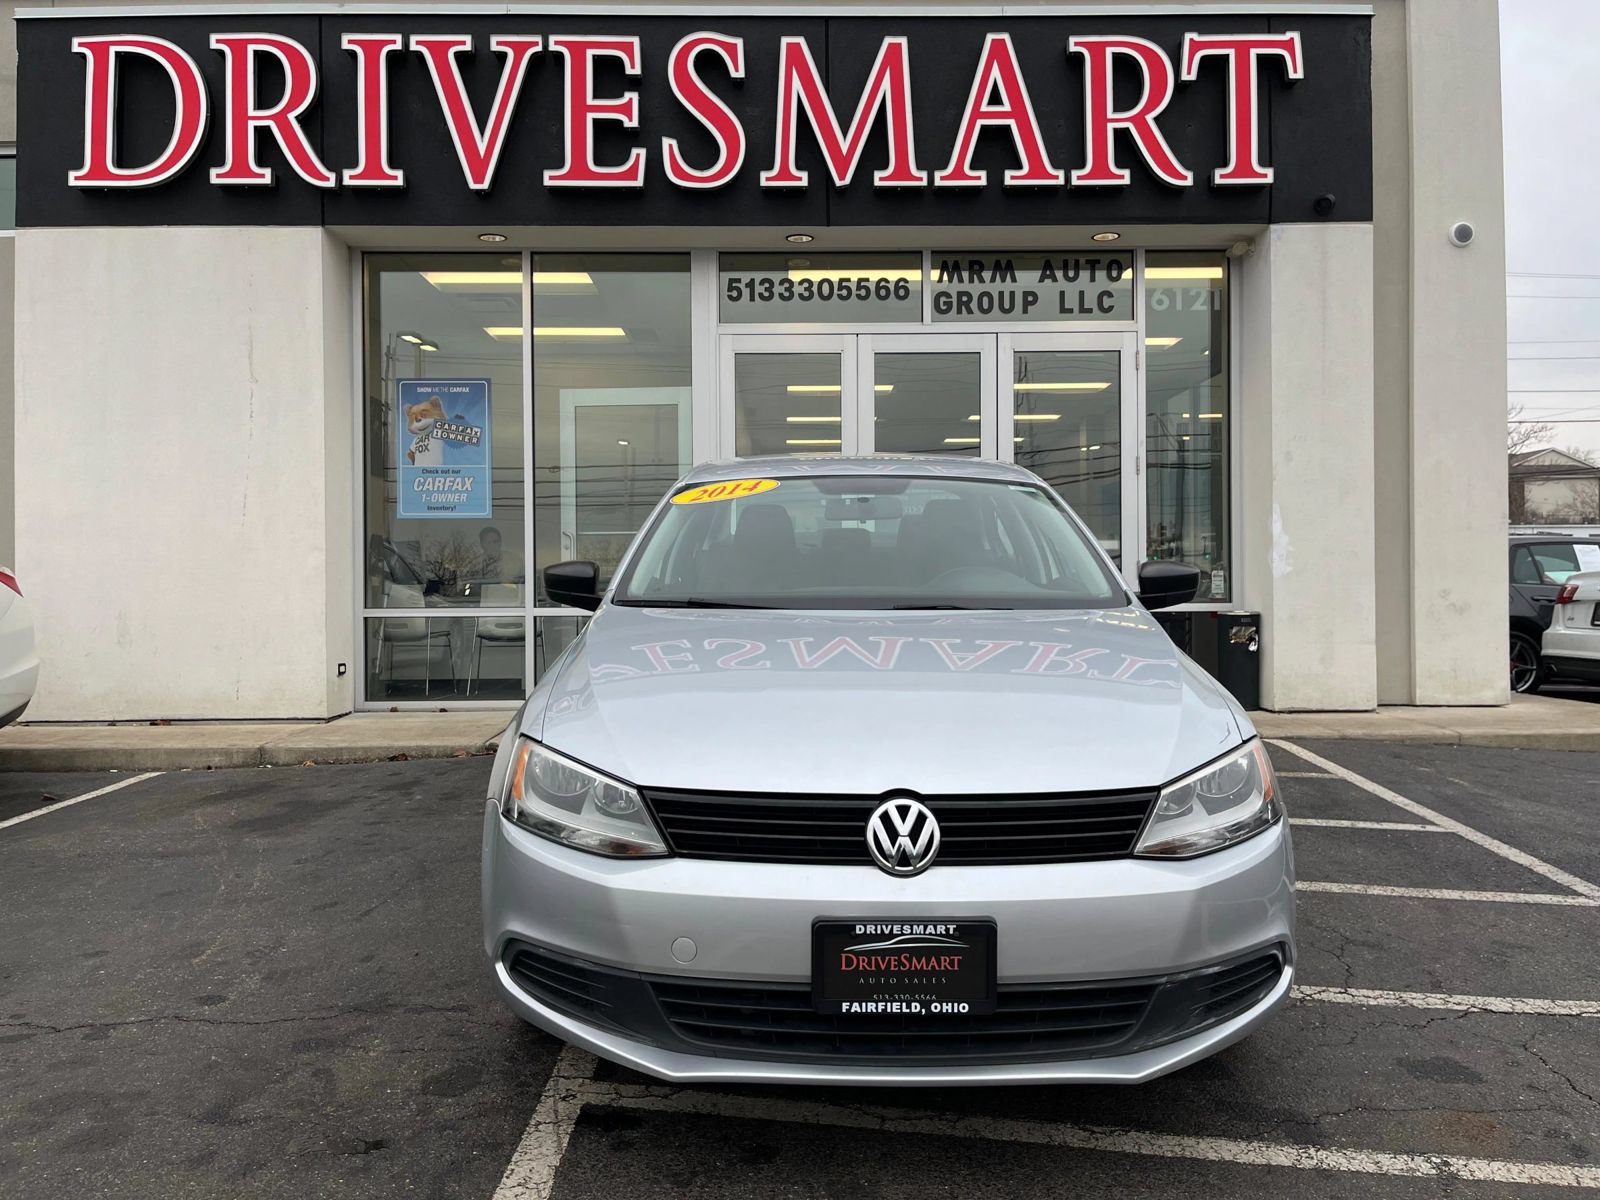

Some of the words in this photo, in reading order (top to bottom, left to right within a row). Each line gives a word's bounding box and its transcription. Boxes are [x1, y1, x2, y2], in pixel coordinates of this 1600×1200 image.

[68, 31, 1304, 190] DRIVESMART
[937, 259, 1018, 284] MRM
[1038, 258, 1123, 283] AUTO
[726, 277, 911, 302] 5133305566
[934, 290, 1039, 314] GROUP
[1059, 290, 1115, 314] LLC
[1150, 287, 1221, 312] 6121
[436, 421, 480, 436] CARFAX
[414, 443, 430, 454] FOX
[413, 477, 474, 492] CARFAX
[689, 480, 762, 502] 2014
[421, 493, 468, 503] 1-OWNER
[855, 924, 957, 935] DRIVESMART
[841, 1002, 926, 1015] FAIRFIELD,
[930, 1002, 970, 1013] OHIO
